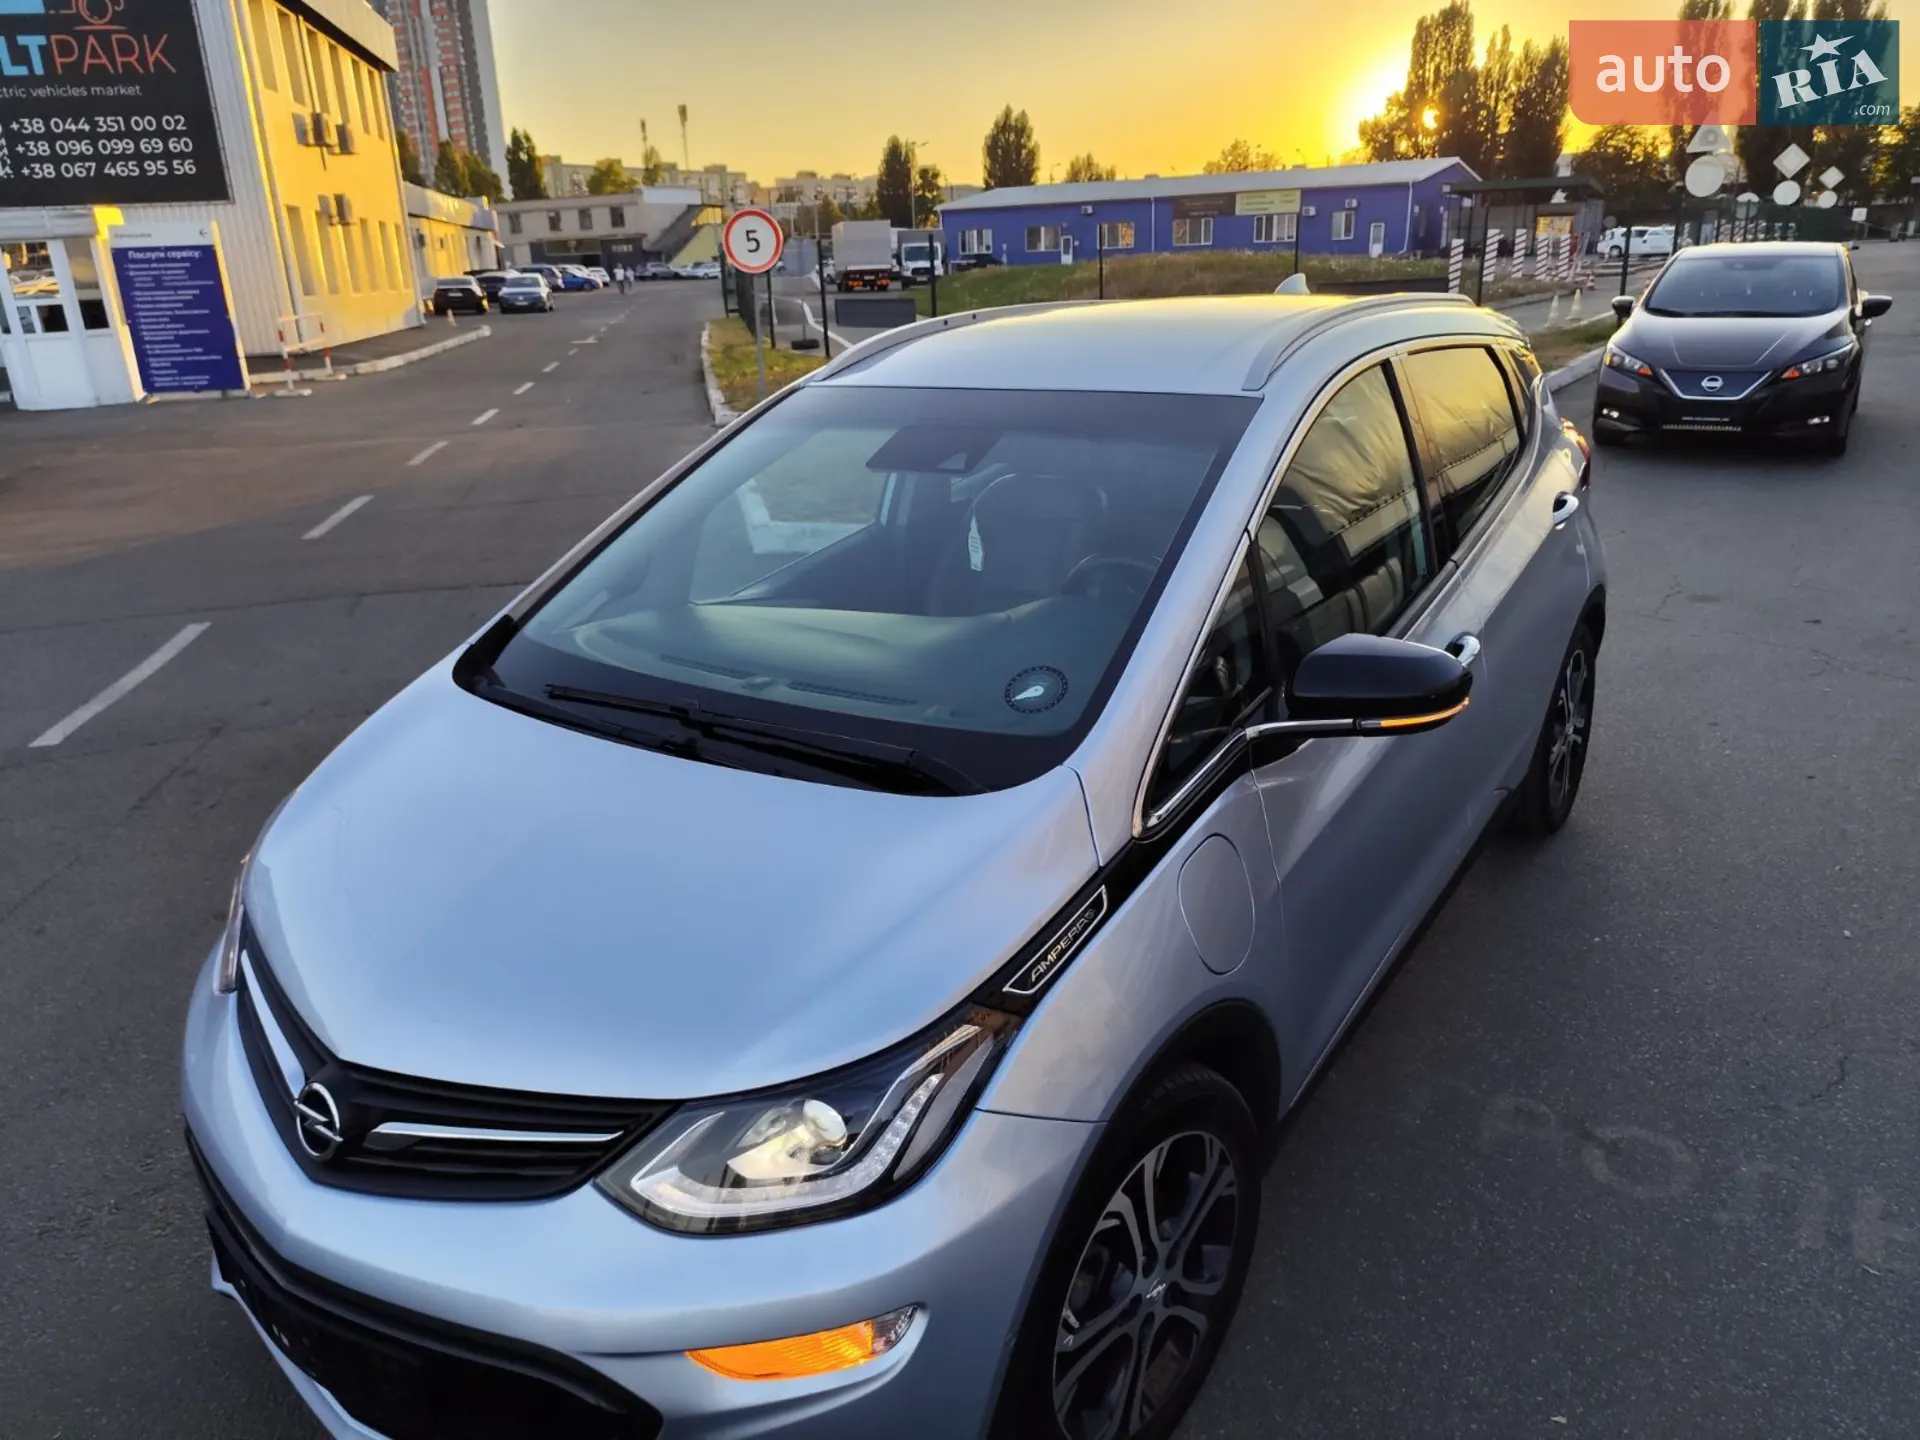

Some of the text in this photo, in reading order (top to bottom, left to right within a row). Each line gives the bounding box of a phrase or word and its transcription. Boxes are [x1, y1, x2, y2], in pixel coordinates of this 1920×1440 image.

[29, 84, 87, 97] vehicles
[91, 84, 142, 96] market
[10, 115, 187, 134] +38 044 351 00 02
[15, 137, 193, 156] +38 096 099 69 60
[21, 159, 196, 178] +38 067 465 95 56
[745, 229, 761, 253] 5
